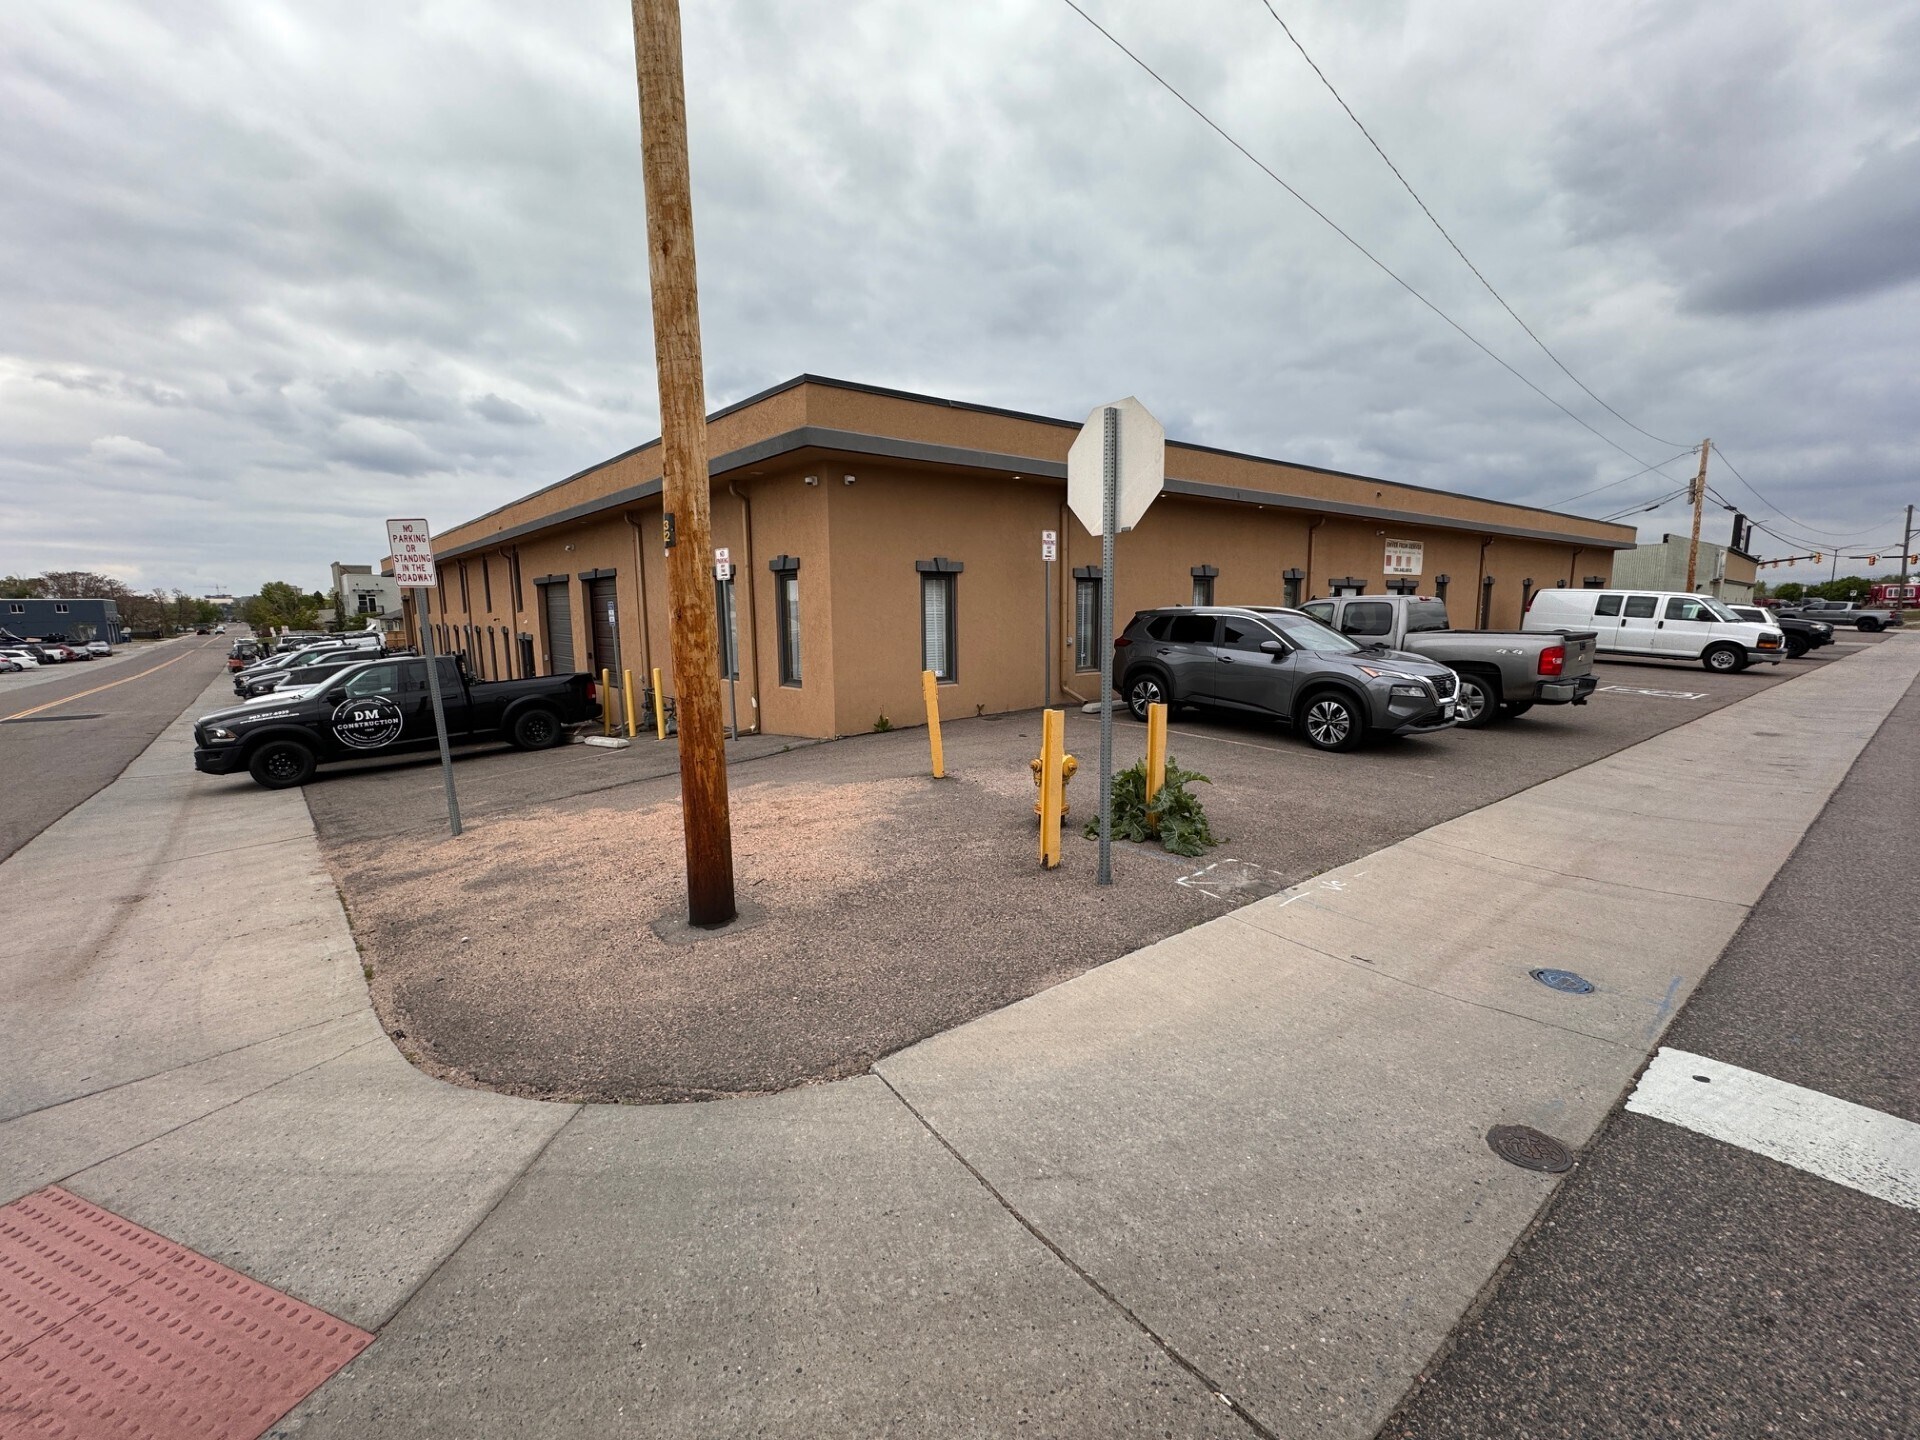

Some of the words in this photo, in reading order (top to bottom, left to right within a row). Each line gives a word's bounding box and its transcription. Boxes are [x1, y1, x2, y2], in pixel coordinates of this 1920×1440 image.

[402, 524, 413, 533] NO
[392, 534, 426, 543] PARKING
[405, 544, 416, 553] OR
[394, 554, 431, 563] STANDING
[402, 564, 409, 572] IN
[412, 564, 426, 572] THE
[397, 573, 433, 582] ROADWAY
[353, 709, 380, 721] DM
[337, 718, 399, 730] CONSTRUCTION
